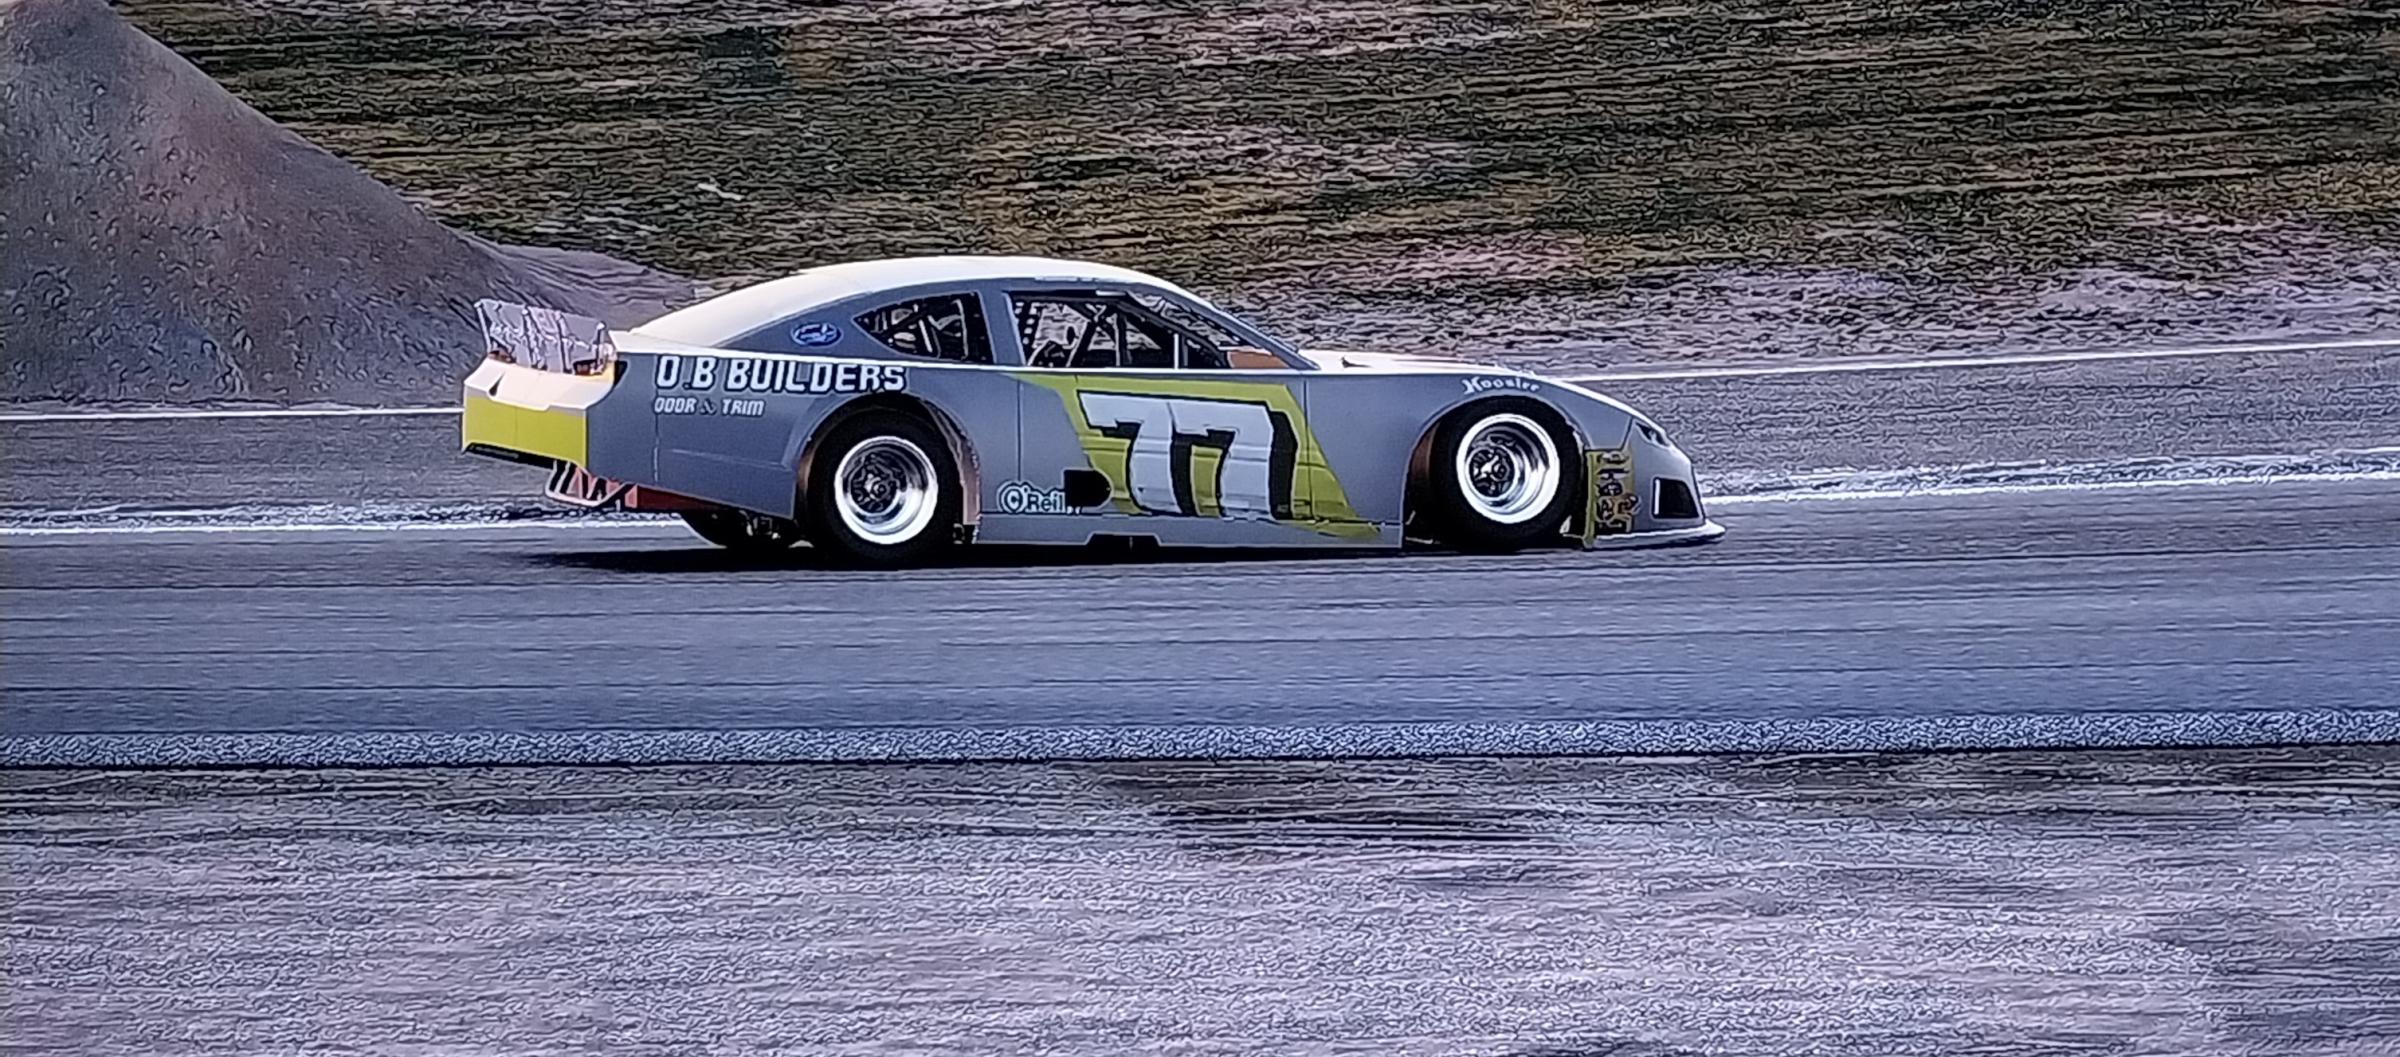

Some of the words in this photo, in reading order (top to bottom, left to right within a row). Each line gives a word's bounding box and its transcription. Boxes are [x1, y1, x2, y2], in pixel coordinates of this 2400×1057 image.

[726, 358, 905, 393] BUILDERS
[1461, 376, 1540, 395] Hoosier
[722, 399, 765, 416] TRIM
[1077, 391, 1276, 519] 77
